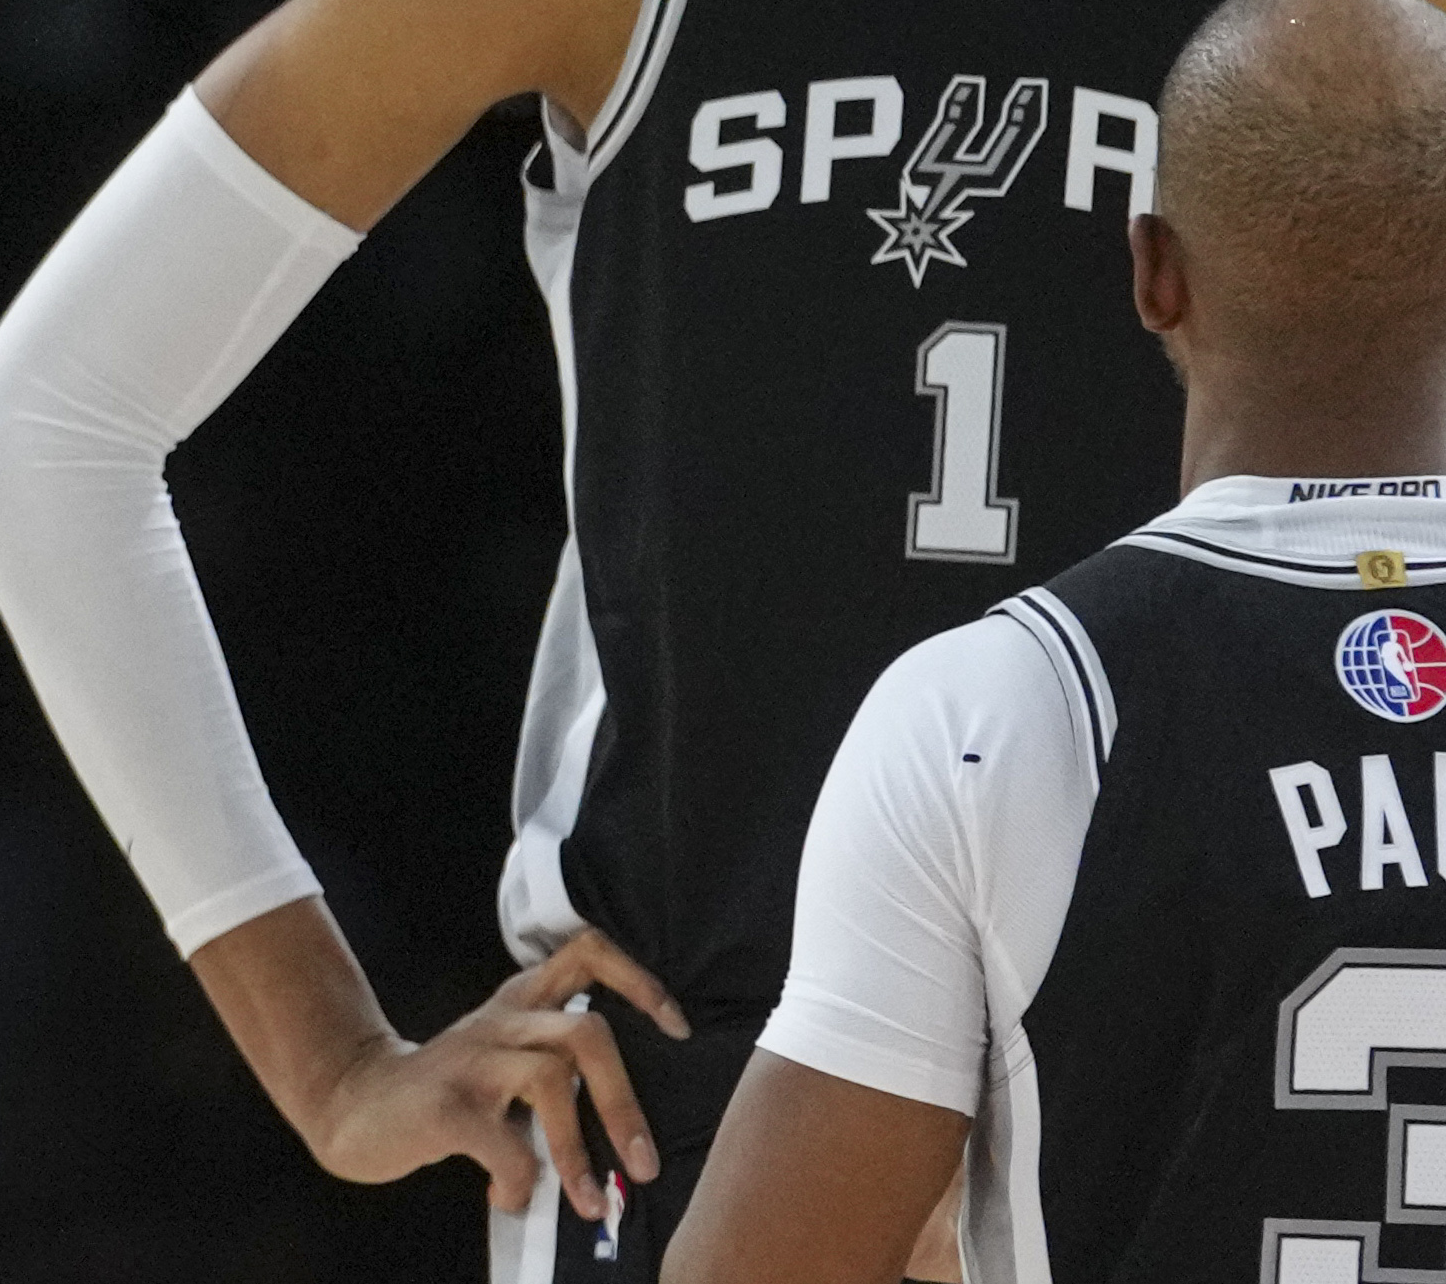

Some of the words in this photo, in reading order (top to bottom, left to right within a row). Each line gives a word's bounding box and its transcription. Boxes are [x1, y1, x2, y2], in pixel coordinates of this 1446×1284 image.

[684, 74, 1159, 289] SPUR
[905, 319, 1018, 564] 1
[1288, 483, 1372, 503] NIKE
